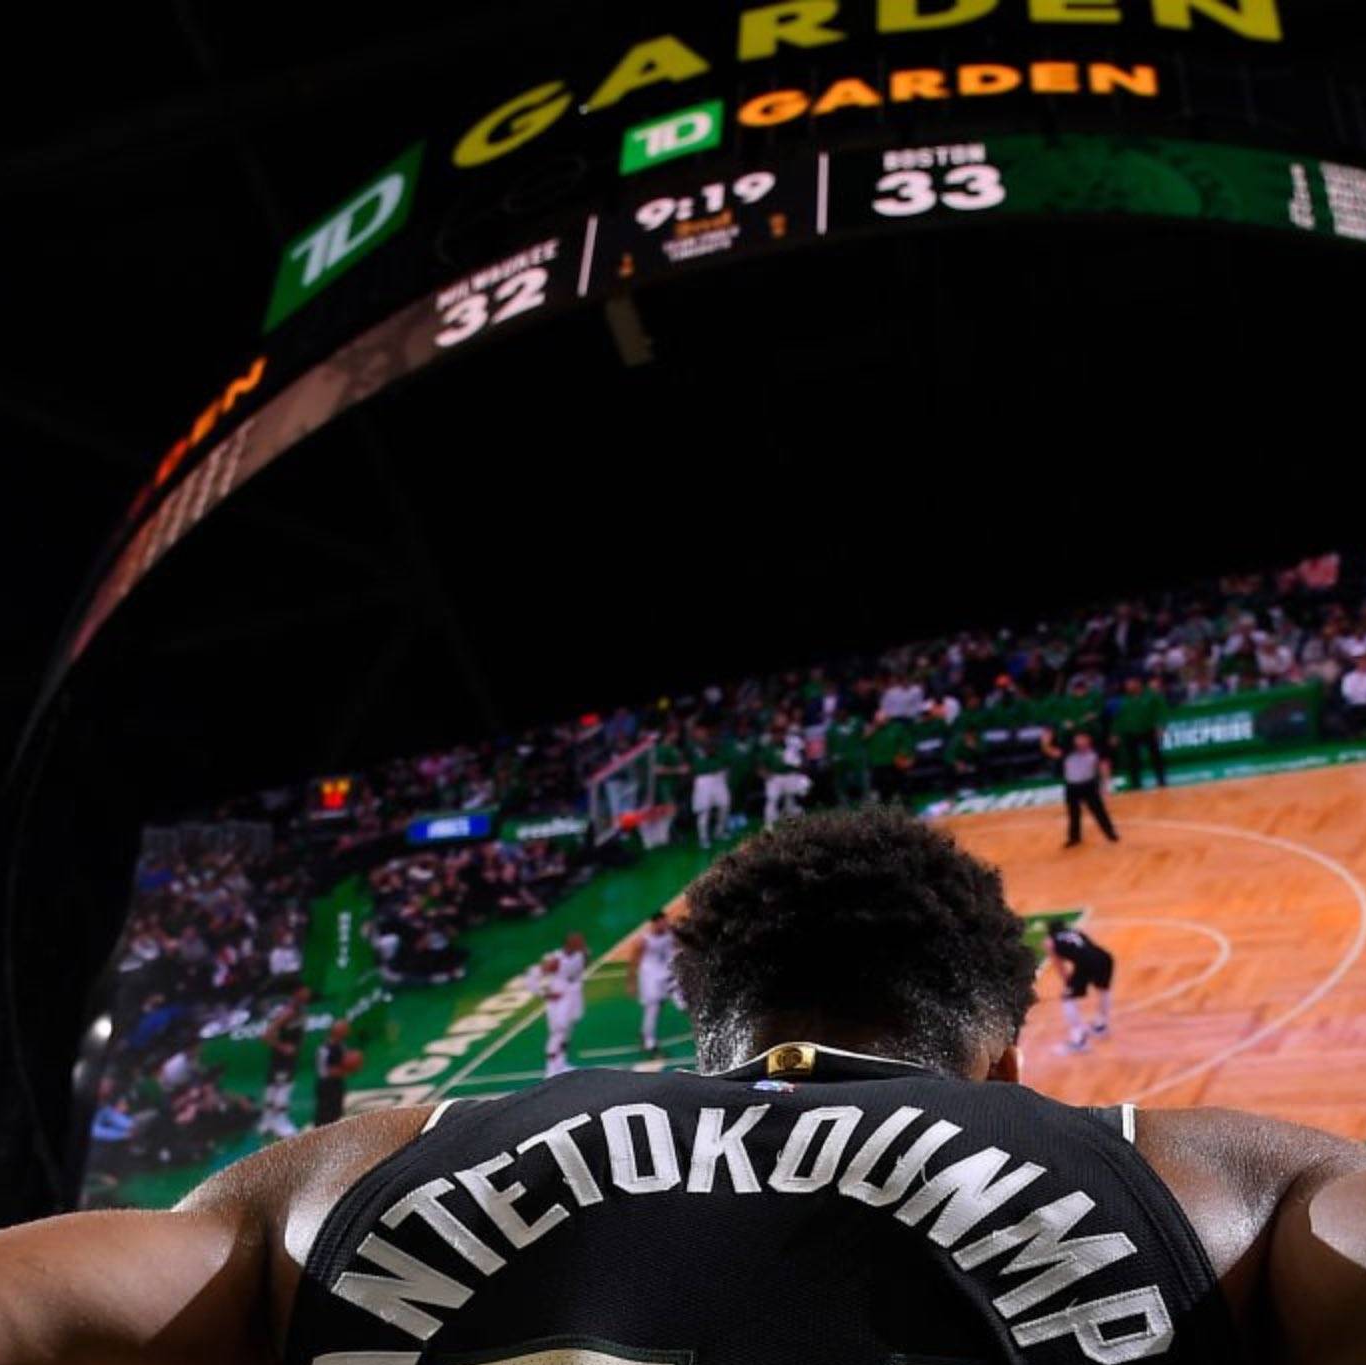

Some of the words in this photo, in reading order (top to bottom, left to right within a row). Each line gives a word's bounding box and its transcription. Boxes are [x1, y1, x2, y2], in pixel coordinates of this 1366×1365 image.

[633, 113, 713, 156] TD
[738, 61, 1160, 128] GARDEN
[882, 142, 987, 172] BOSTON
[635, 171, 777, 231] 9:19
[871, 163, 1007, 217] 33
[434, 266, 550, 347] 32
